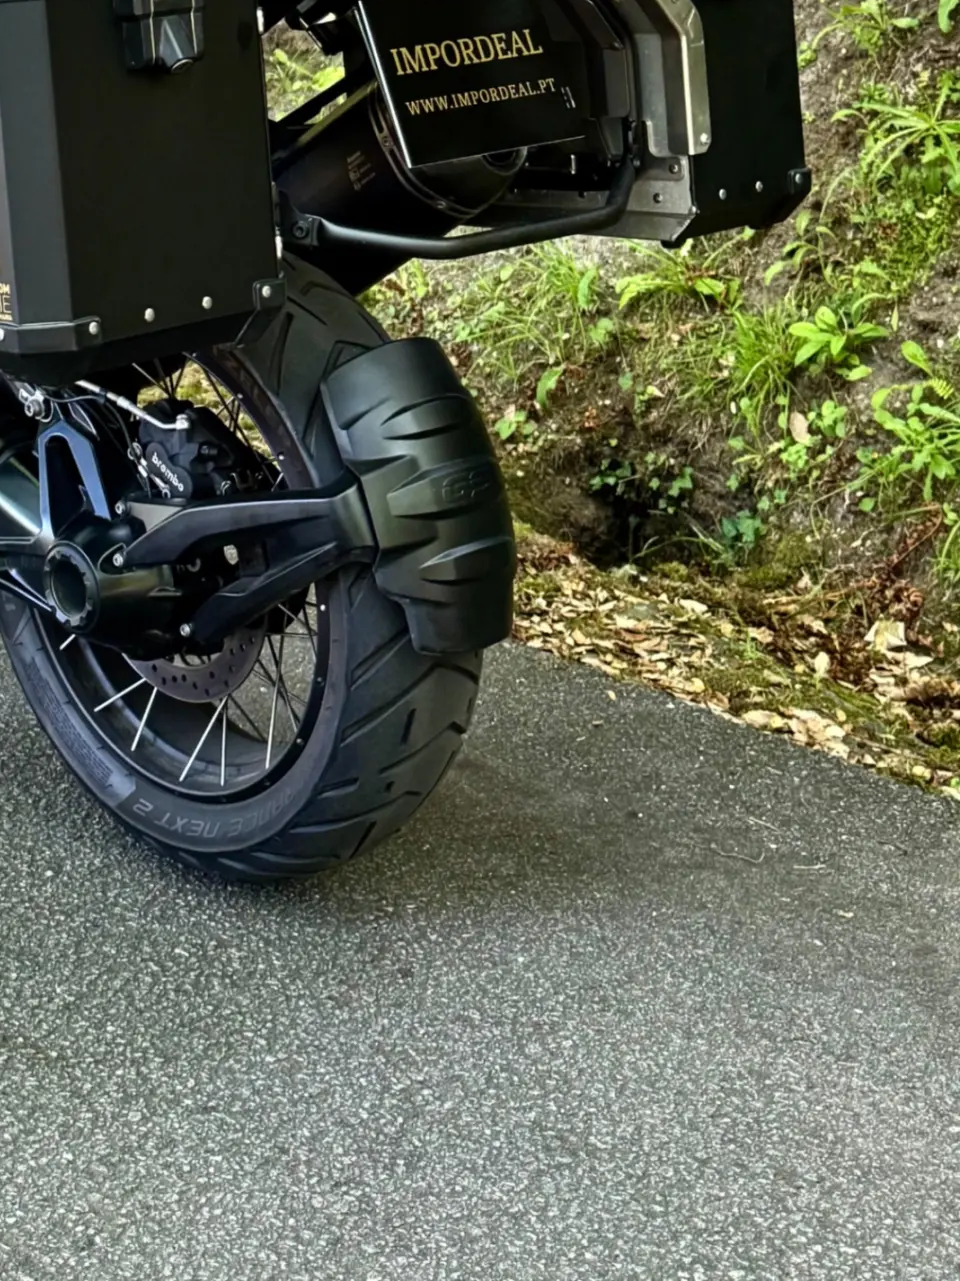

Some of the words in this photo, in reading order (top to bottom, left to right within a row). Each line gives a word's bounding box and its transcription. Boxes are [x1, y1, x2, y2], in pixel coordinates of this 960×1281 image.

[390, 28, 543, 77] IMPORDEAL
[405, 77, 557, 116] WWW.IMPORDEAL.PT
[151, 451, 184, 492] brembo
[132, 798, 154, 818] 2
[155, 811, 220, 838] NEXT
